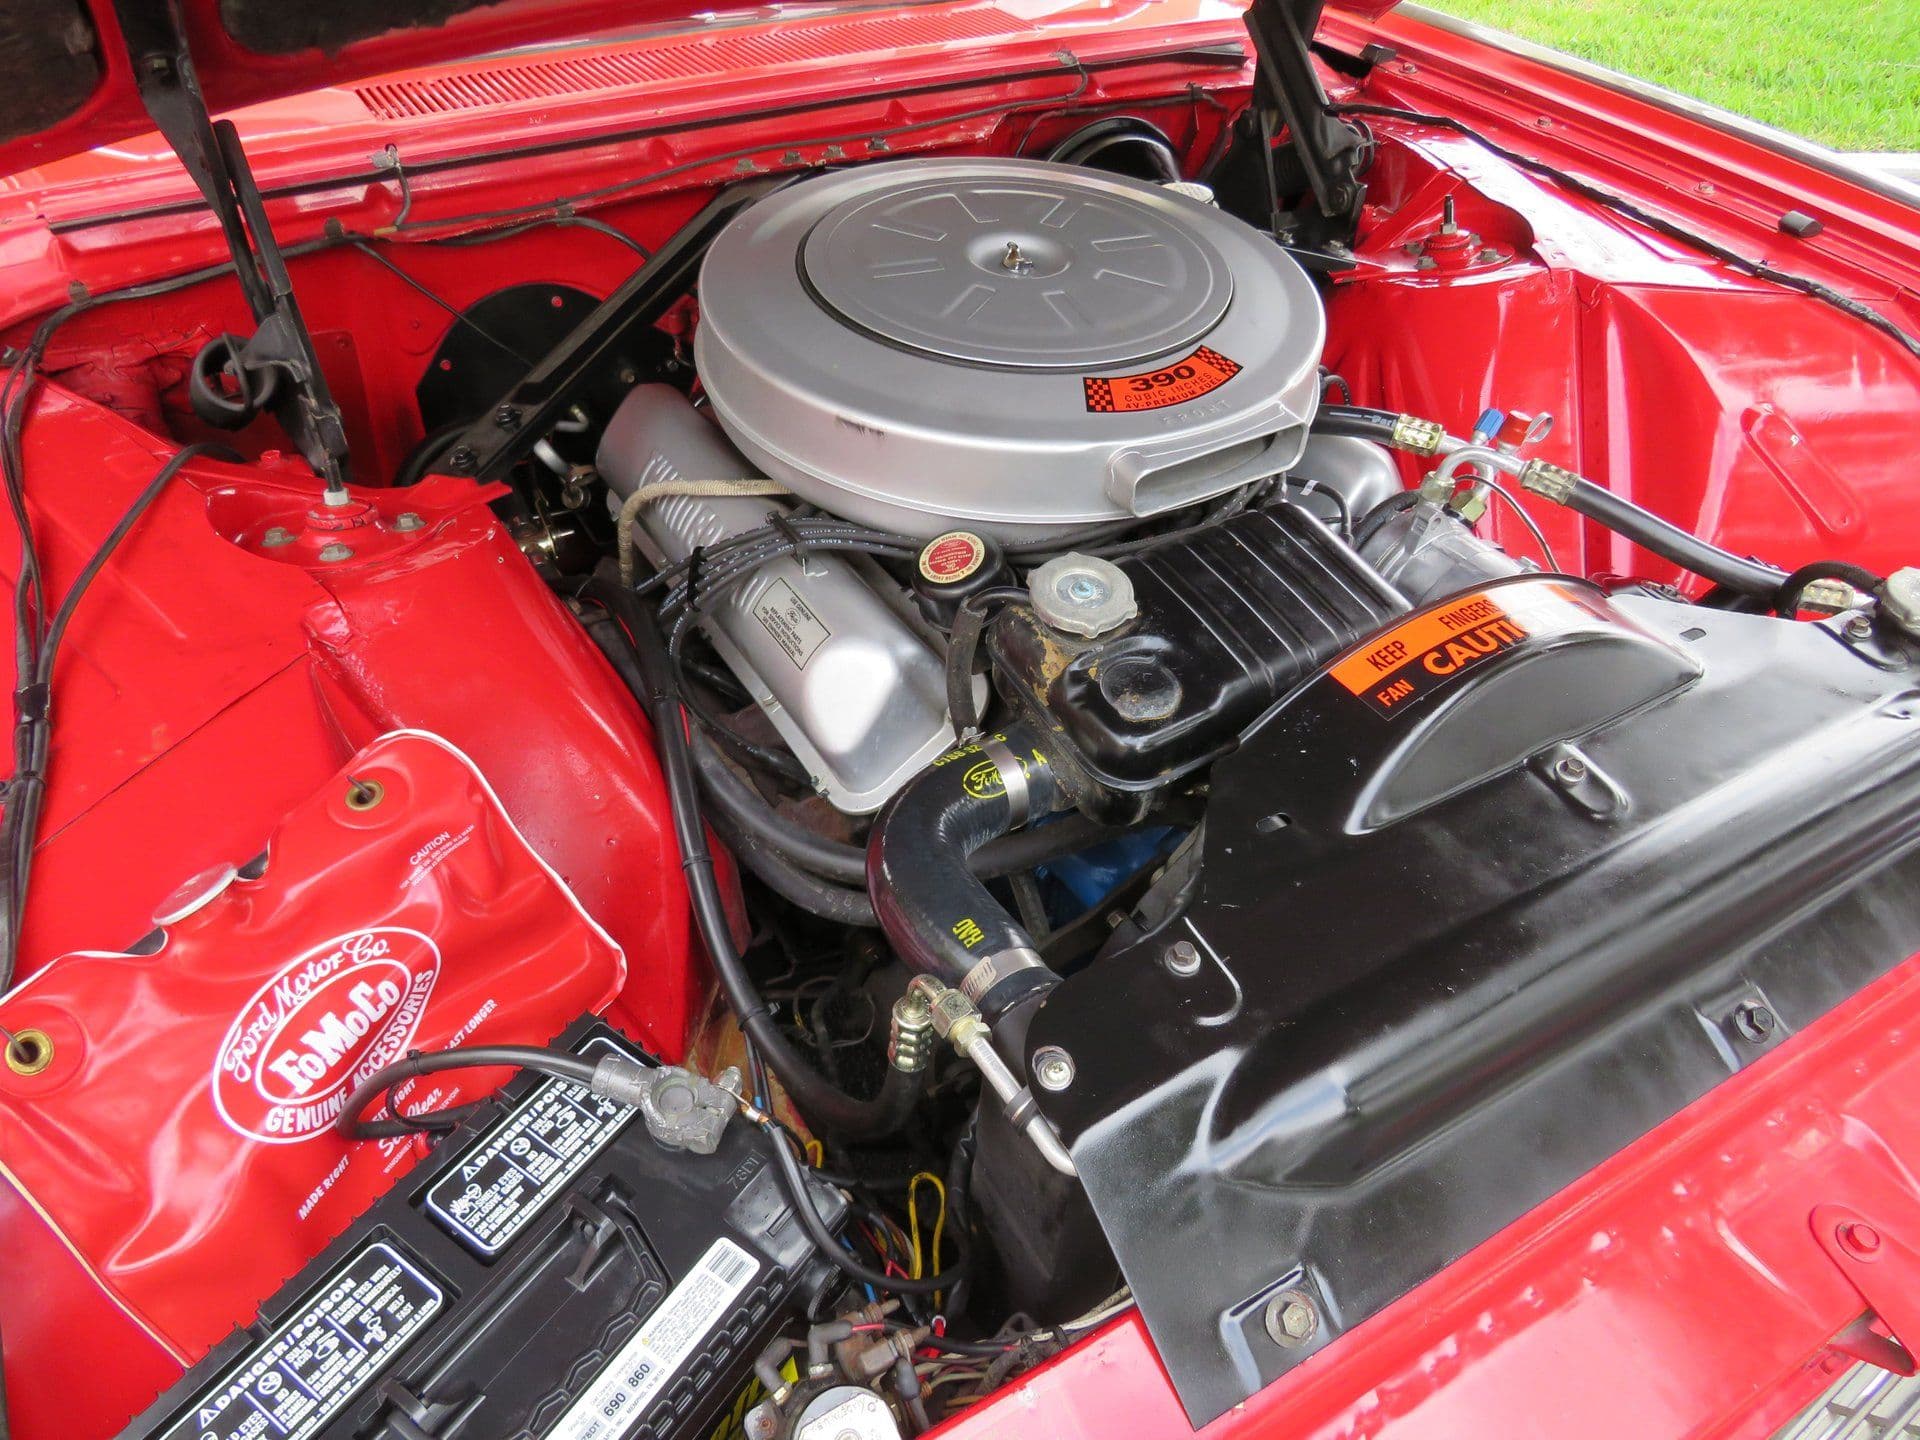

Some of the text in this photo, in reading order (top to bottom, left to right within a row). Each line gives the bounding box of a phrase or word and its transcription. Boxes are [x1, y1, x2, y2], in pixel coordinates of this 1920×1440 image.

[1124, 372, 1212, 402] CUBIC INCHES
[1129, 365, 1196, 392] 390
[1200, 377, 1222, 393] FUEL
[1366, 599, 1500, 672] KEEP FINGERS
[1376, 617, 1528, 708] FAN CAUTI
[409, 831, 451, 866] CAUTION
[223, 1002, 279, 1084] Ford
[273, 951, 345, 1018] Motor
[444, 999, 497, 1050] AST LONGER
[265, 968, 434, 1134] GENUINE ACCESSORIES
[267, 980, 401, 1096] FoMoCo
[394, 1078, 416, 1108] IGHT
[476, 1078, 568, 1167] DANGER/POIS
[531, 1102, 561, 1131] SULFURIC
[538, 1120, 555, 1136] ACID
[526, 1150, 538, 1161] NO
[298, 1155, 349, 1220] MADE RIGHT
[466, 1173, 524, 1228] EXPLOSIVE GASES
[475, 1168, 517, 1207] SHIELD EYES
[474, 1221, 488, 1234] CAN
[486, 1204, 506, 1223] CAUSE
[331, 1265, 389, 1319] FLUSH EYES WITH
[338, 1265, 402, 1326] WATER IMMEDIATELY
[359, 1284, 401, 1324] GET MEDICAL
[387, 1295, 405, 1313] HELP
[396, 1302, 414, 1321] FAST
[216, 1279, 355, 1409] DANGER/POISON
[285, 1326, 324, 1363] SULFURIC
[292, 1349, 313, 1369] ACID
[306, 1370, 322, 1385] CAN
[627, 1362, 650, 1388] 860
[275, 1388, 289, 1402] NO
[279, 1396, 307, 1423] FLAMES
[603, 1391, 626, 1417] 690
[239, 1410, 262, 1434] EYES
